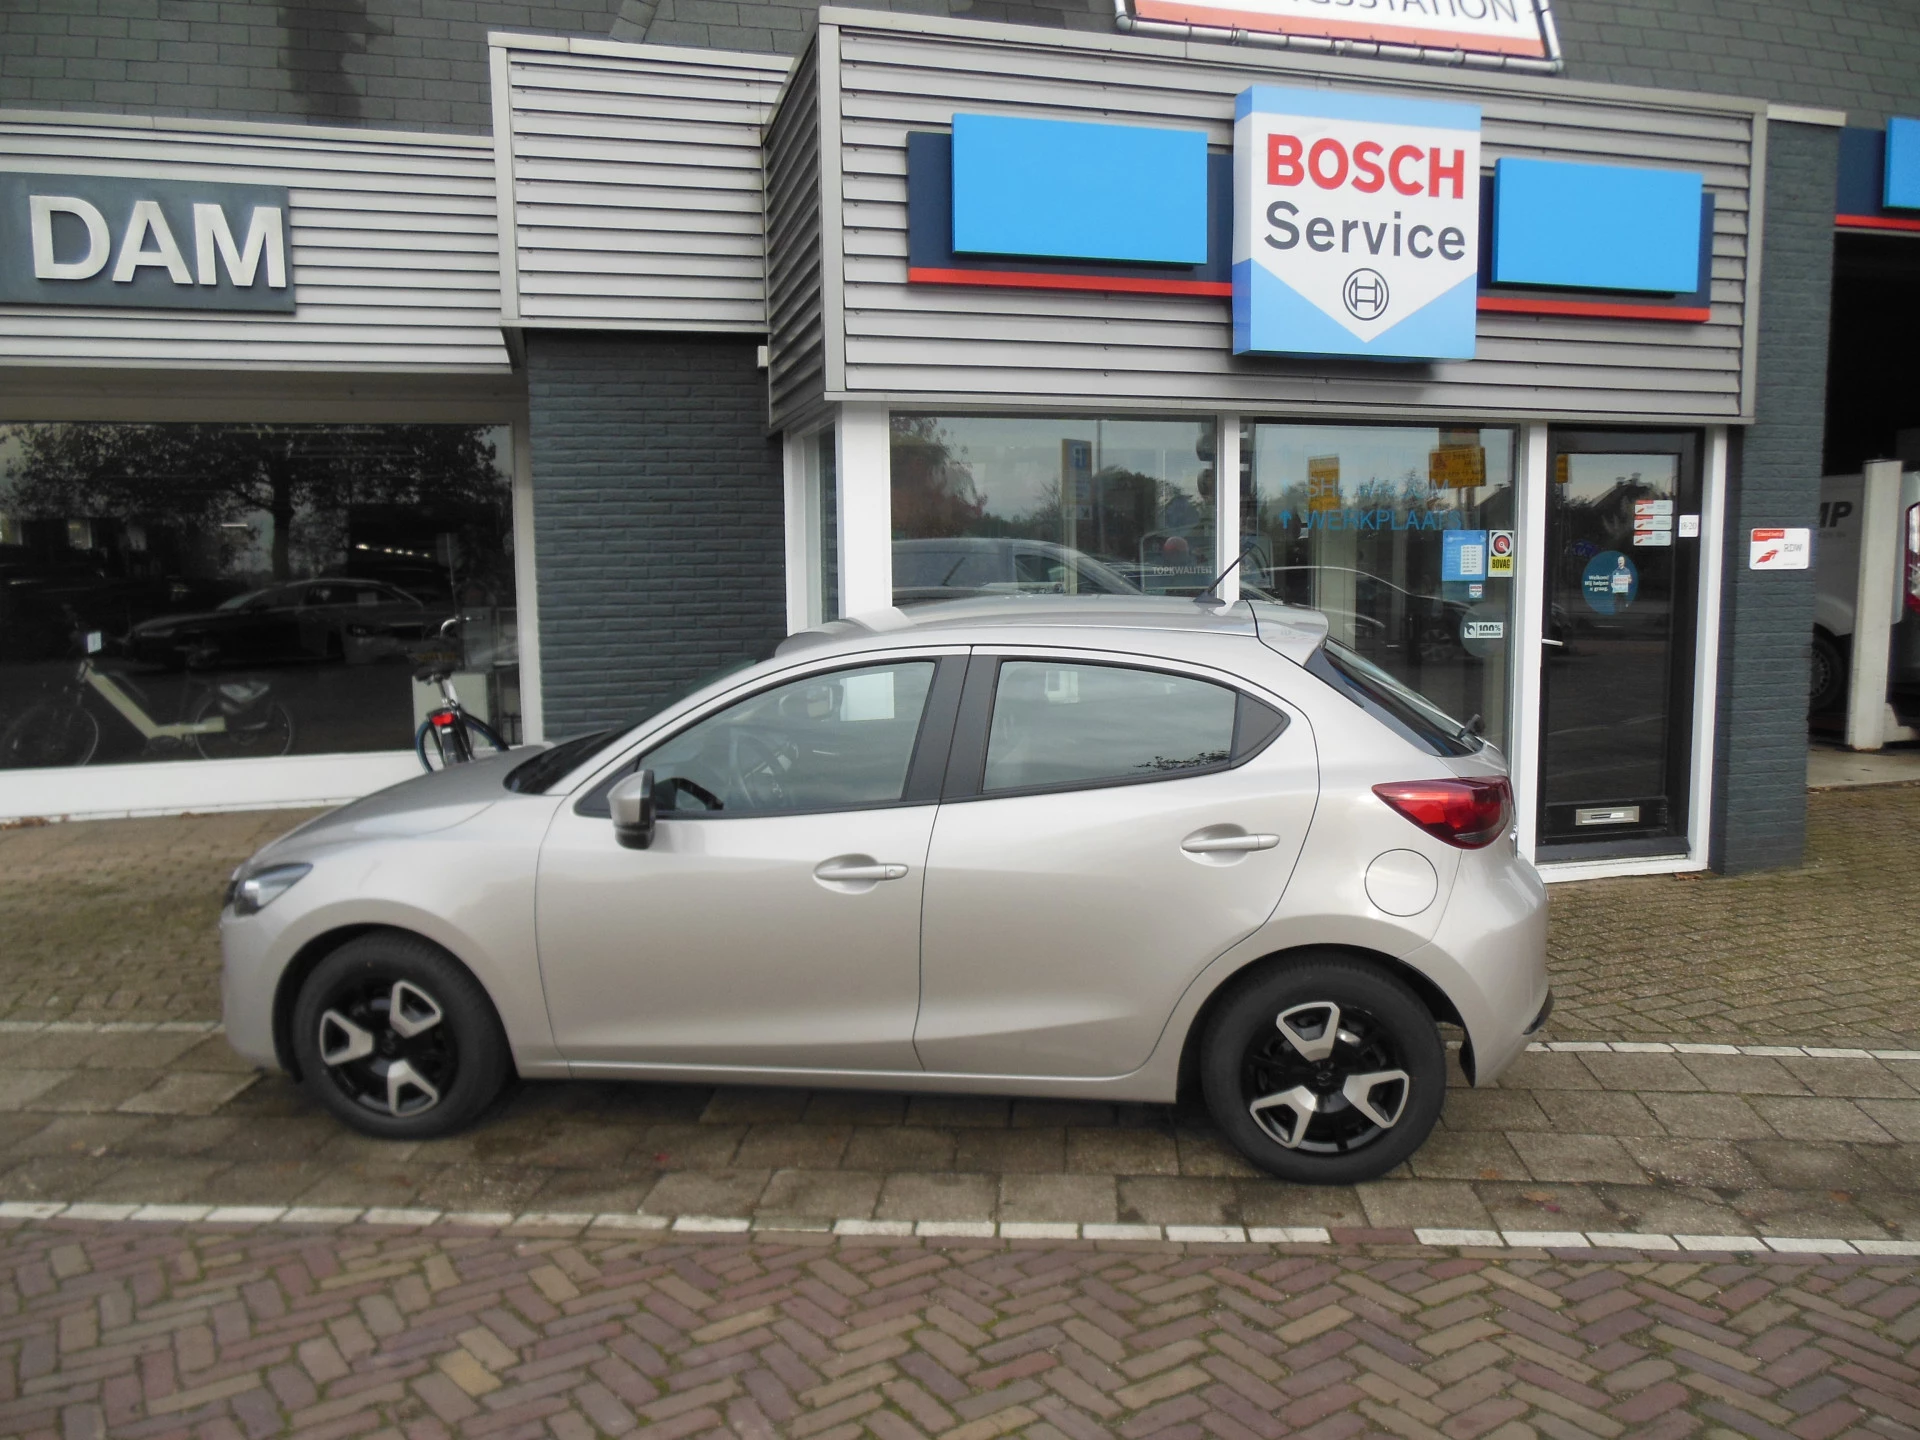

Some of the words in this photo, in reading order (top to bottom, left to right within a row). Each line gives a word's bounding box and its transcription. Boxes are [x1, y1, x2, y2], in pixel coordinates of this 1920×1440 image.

[1266, 133, 1465, 200] BOSCH
[29, 194, 288, 289] DAM
[1263, 200, 1466, 261] Service
[1304, 509, 1462, 531] WERKPLAATS
[1491, 558, 1511, 570] BOVAG
[1478, 624, 1501, 632] 100%
